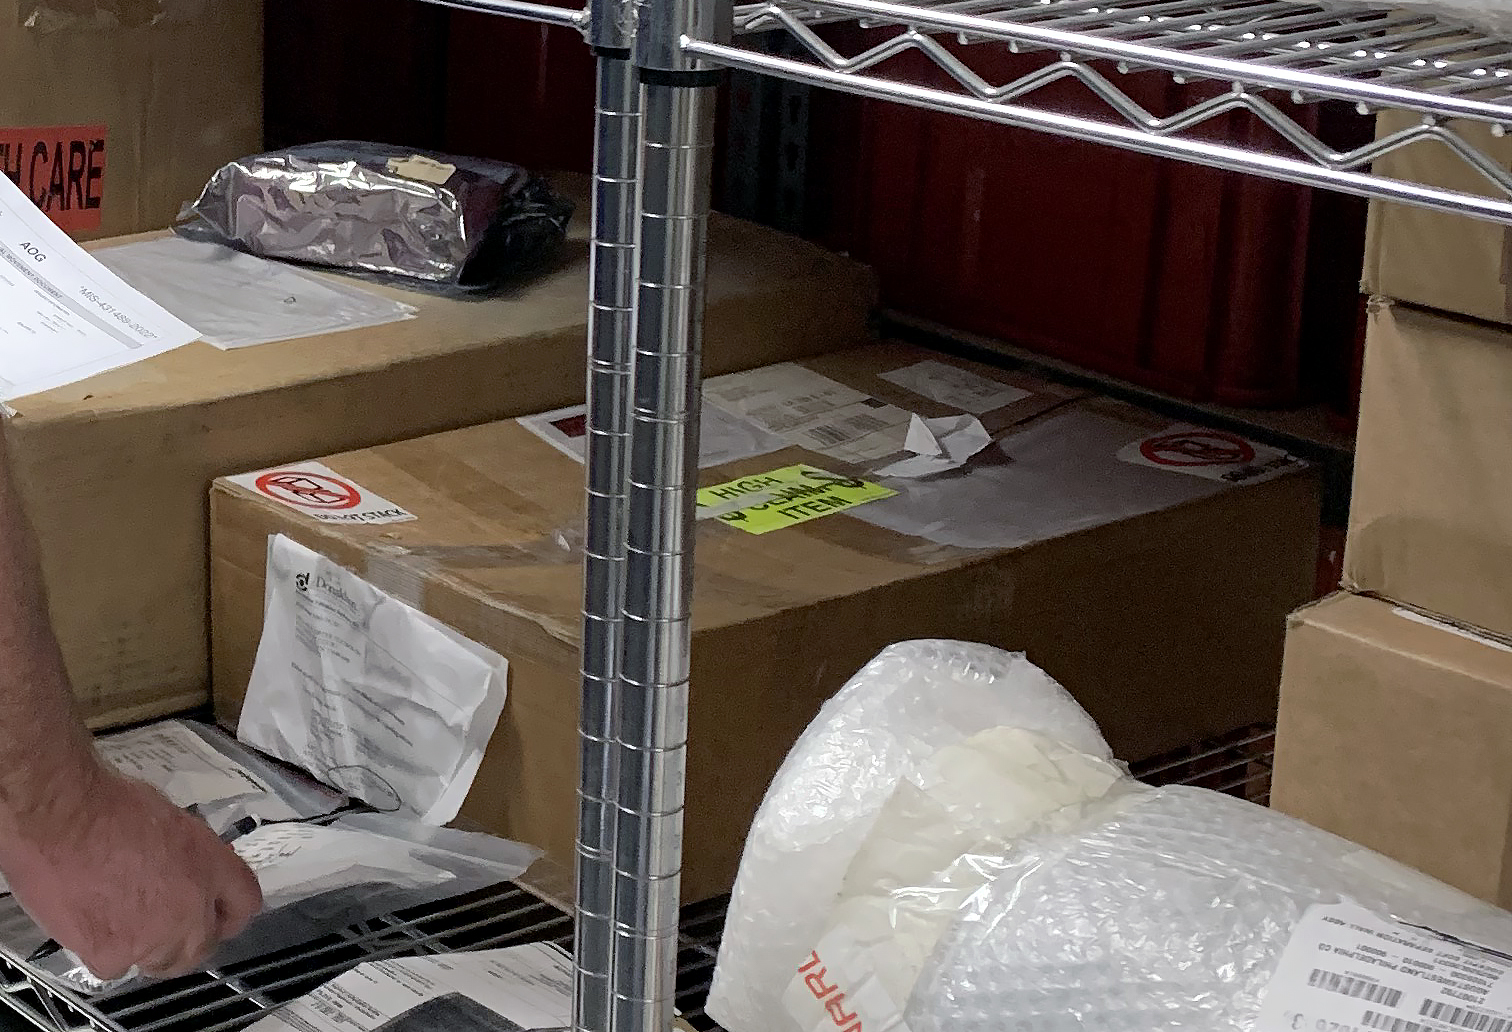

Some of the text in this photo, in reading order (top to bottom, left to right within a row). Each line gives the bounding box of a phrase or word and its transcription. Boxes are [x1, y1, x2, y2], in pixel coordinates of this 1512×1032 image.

[29, 139, 104, 212] CARE
[20, 242, 46, 262] AOG
[709, 476, 783, 500] HIGH
[777, 495, 852, 519] ITEM
